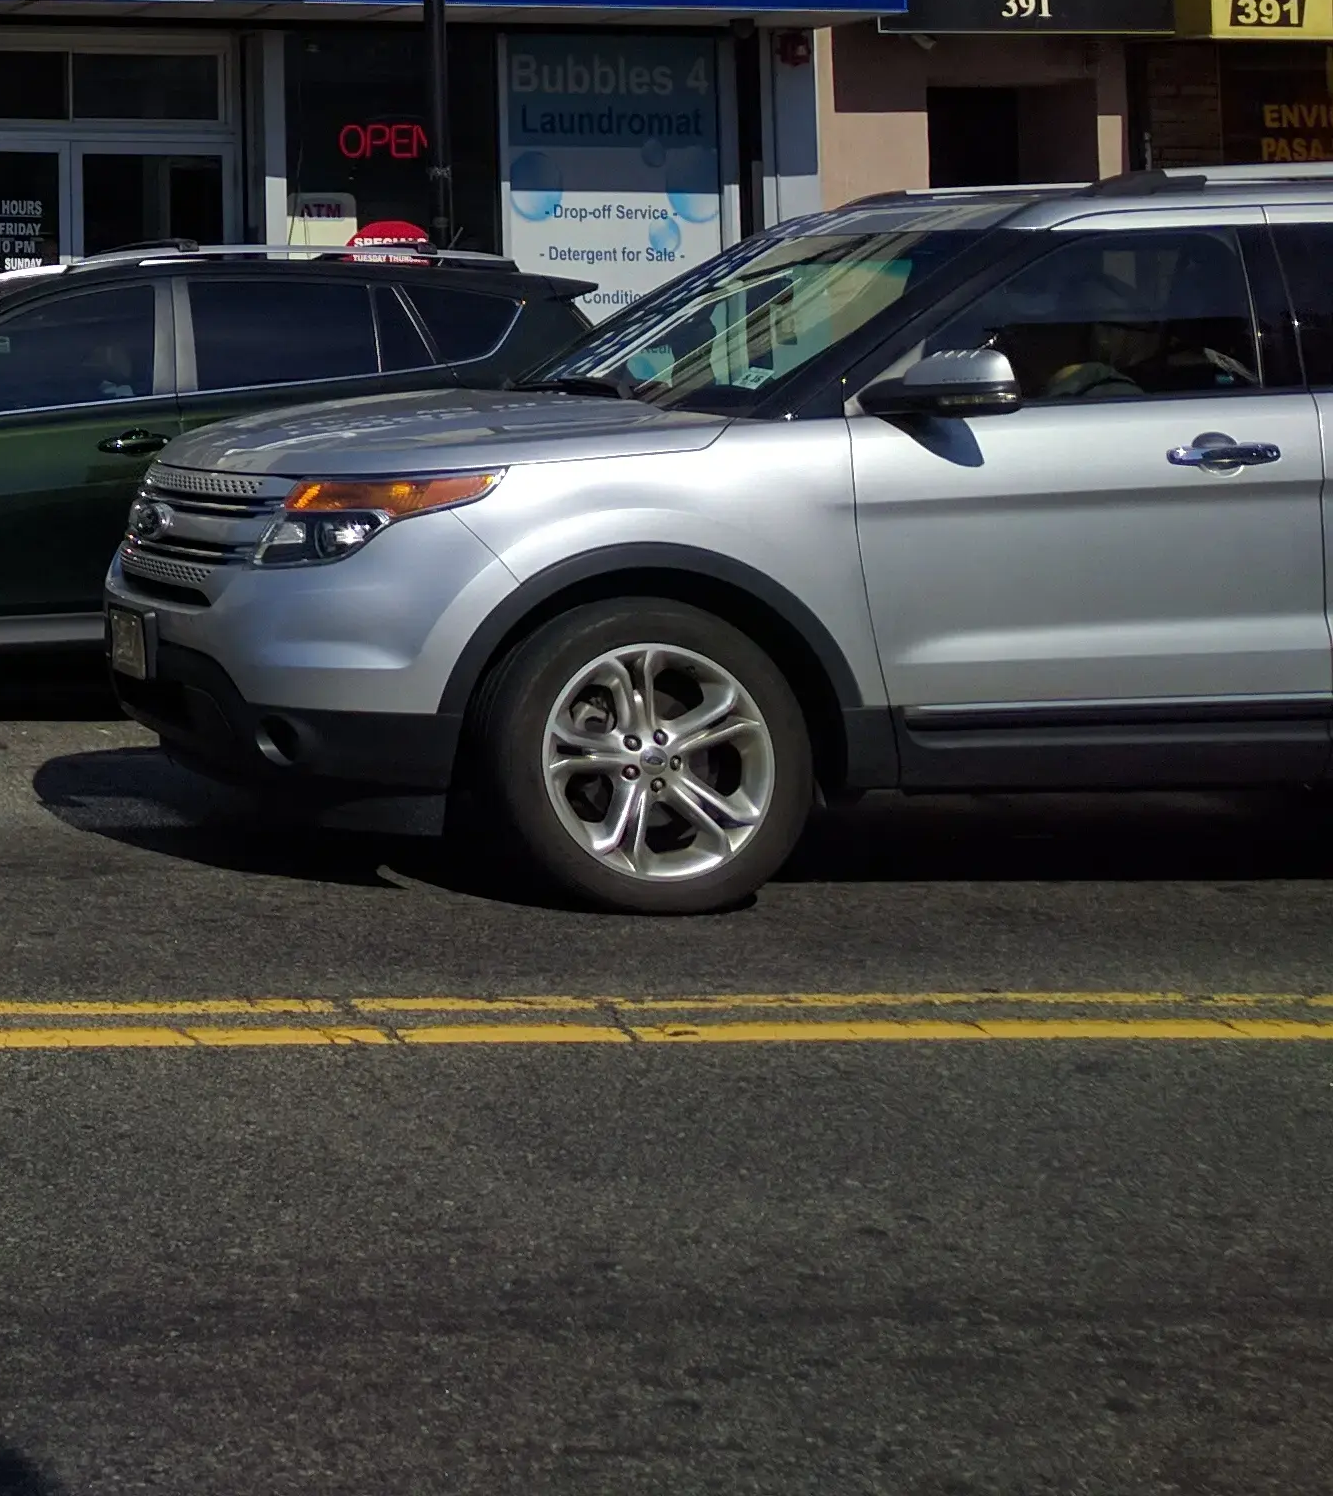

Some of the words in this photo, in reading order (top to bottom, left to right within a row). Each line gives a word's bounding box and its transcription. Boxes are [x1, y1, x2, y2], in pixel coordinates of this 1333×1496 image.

[511, 54, 674, 96] Bubbles
[685, 56, 709, 94] 4
[521, 105, 703, 136] Laundromat
[1, 199, 43, 215] HOURS
[300, 203, 342, 218] ATM
[553, 204, 613, 222] Drop-off
[616, 205, 669, 220] Service
[14, 241, 36, 253] PM
[548, 246, 618, 264] Detergent
[621, 247, 642, 262] for
[645, 248, 676, 262] Sale
[4, 257, 43, 271] SUNDAY
[352, 254, 387, 263] TUESDAY
